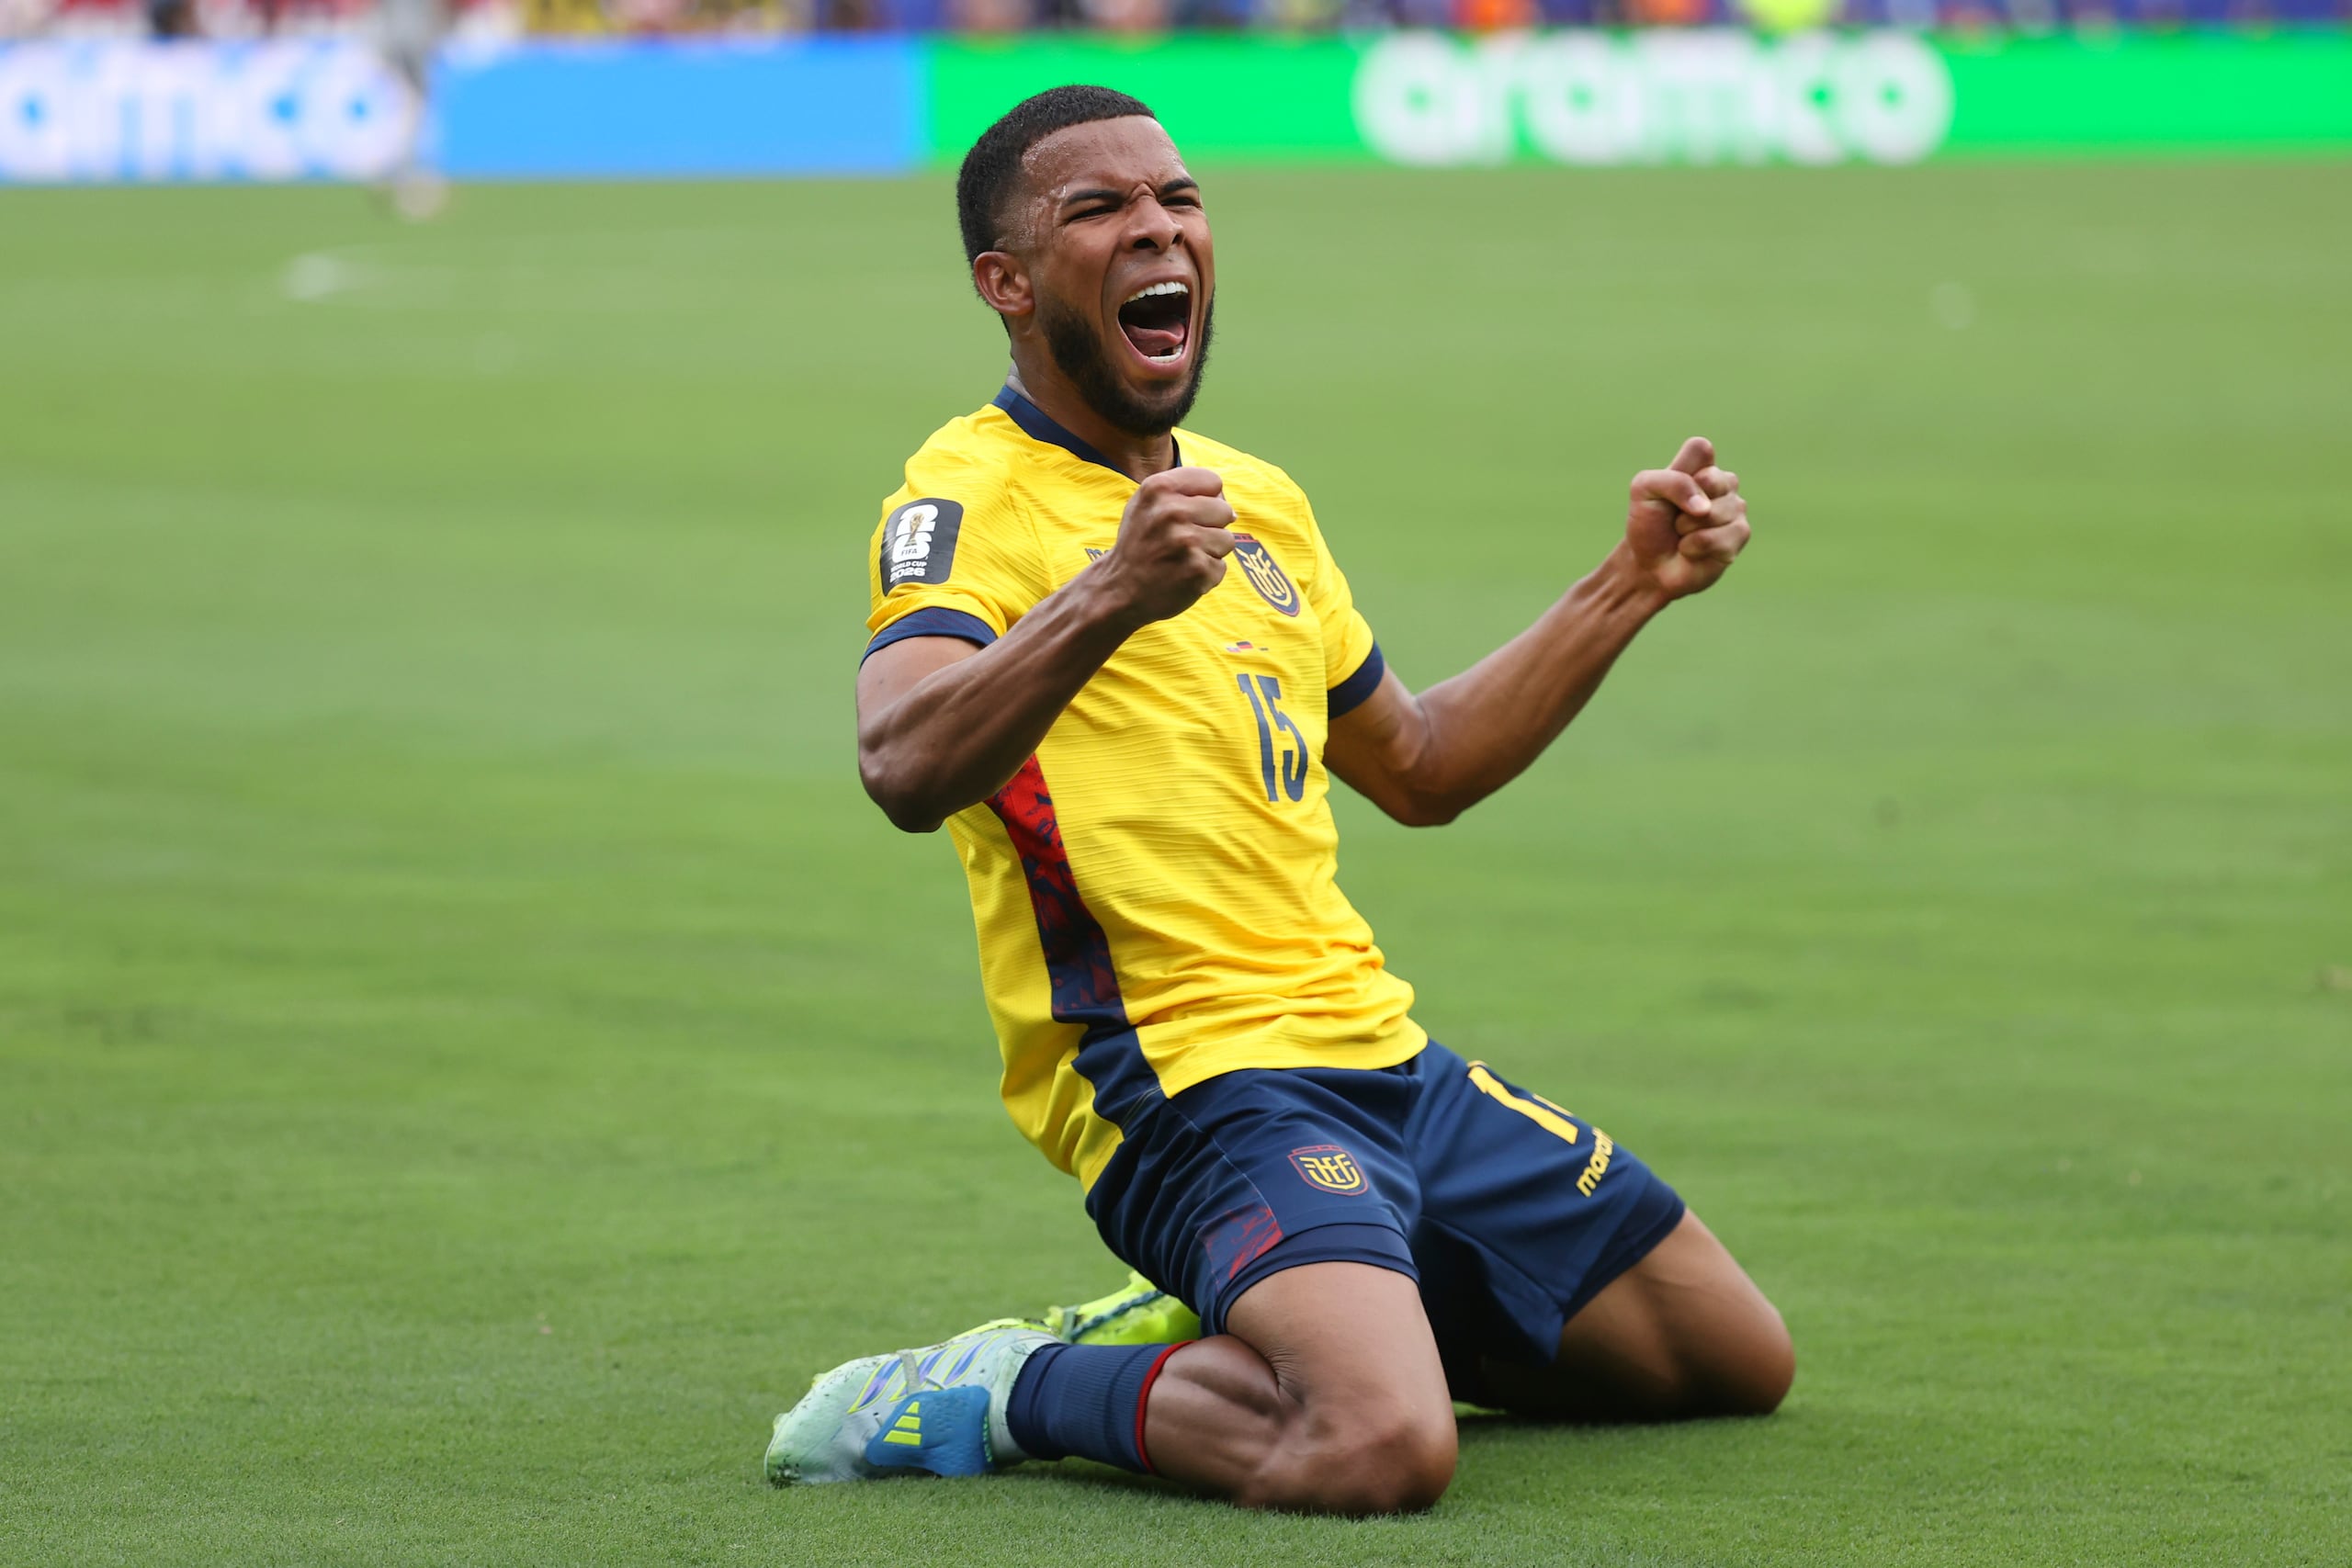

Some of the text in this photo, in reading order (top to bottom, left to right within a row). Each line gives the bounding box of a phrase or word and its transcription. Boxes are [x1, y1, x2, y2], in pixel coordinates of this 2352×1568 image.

[1351, 29, 1955, 167] aramco
[889, 567, 926, 583] 2026
[890, 561, 911, 573] WORLD
[900, 547, 918, 556] FIFA
[1236, 673, 1308, 803] 15
[1467, 1060, 1578, 1145] 1
